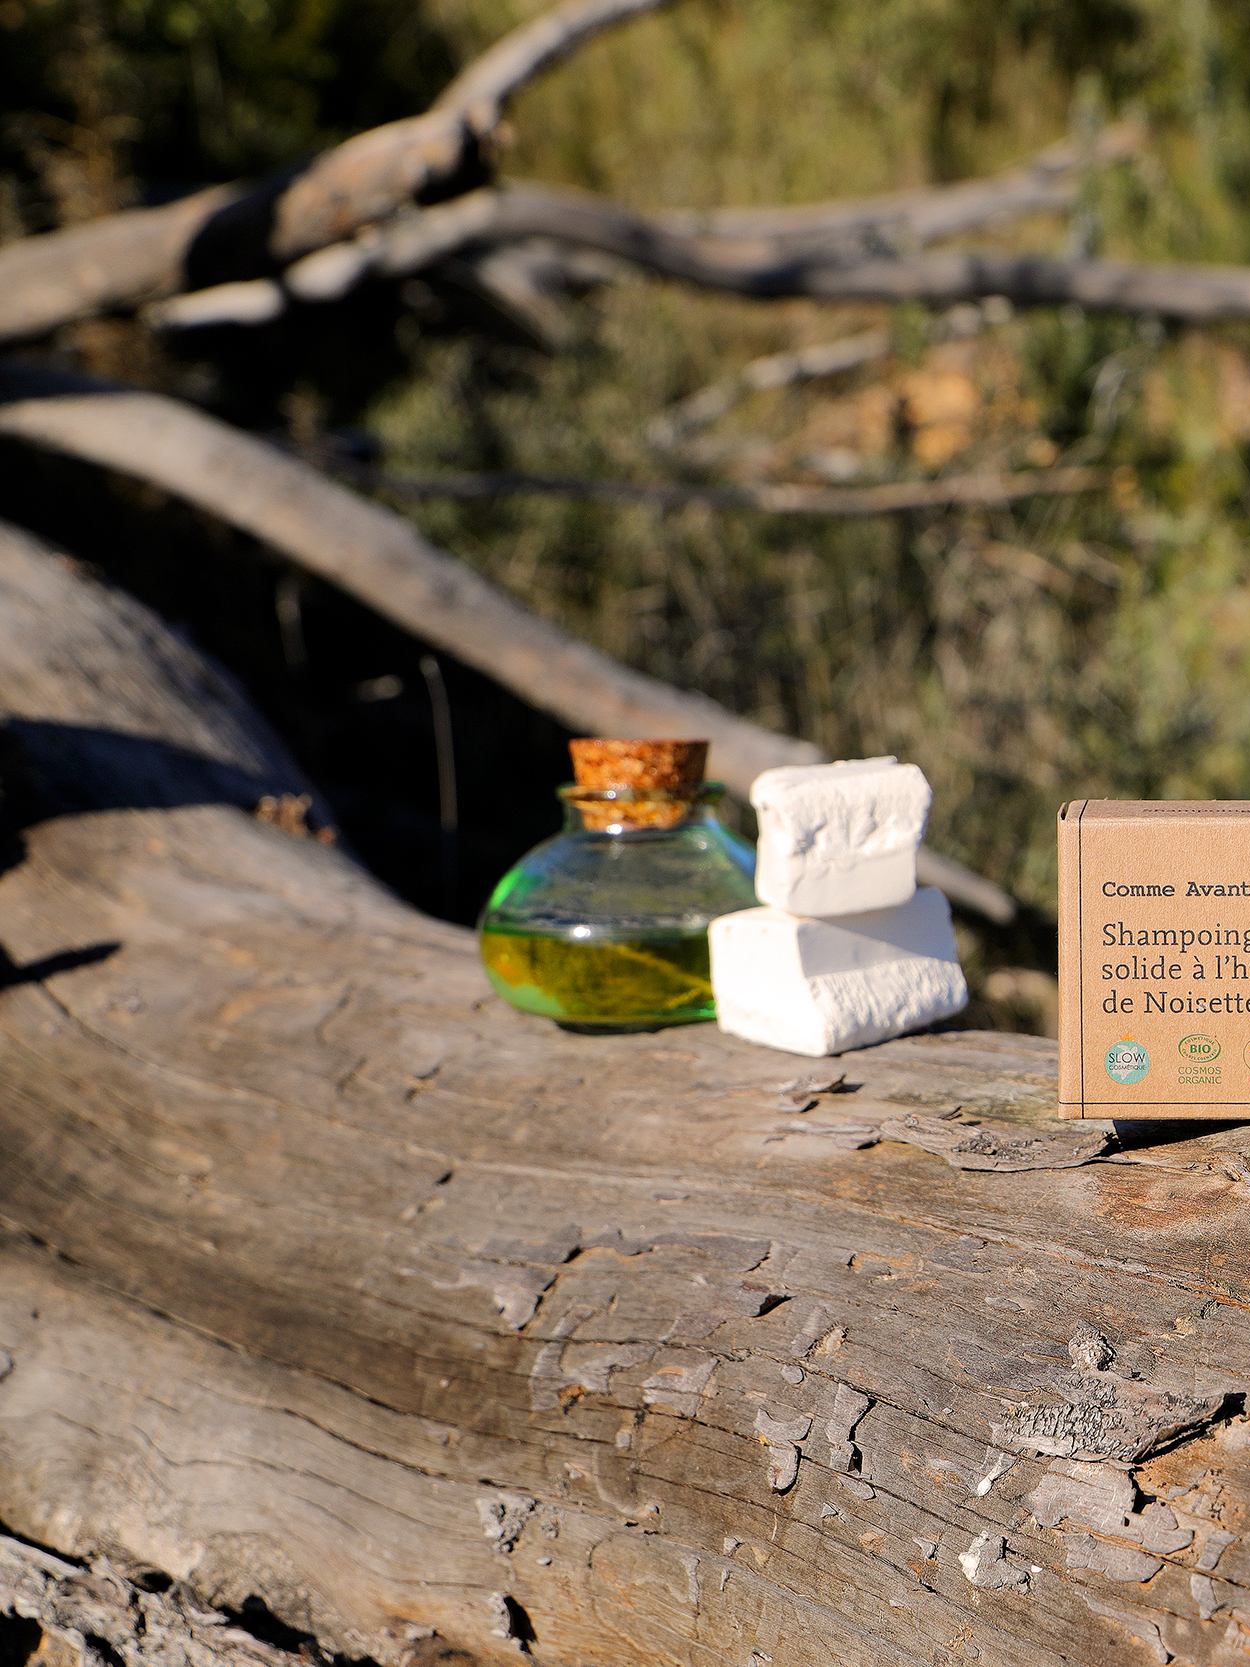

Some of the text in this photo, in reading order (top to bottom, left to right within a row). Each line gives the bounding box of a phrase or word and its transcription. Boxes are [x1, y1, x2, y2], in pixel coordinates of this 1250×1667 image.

[1102, 881, 1176, 897] Comme
[1101, 955, 1182, 980] solide
[1192, 955, 1206, 980] à
[1102, 989, 1134, 1014] de
[1190, 1044, 1211, 1053] BIO
[1108, 1052, 1146, 1063] SLOW
[1178, 1066, 1222, 1075] COSMOS
[1178, 1076, 1222, 1085] ORGANIC
